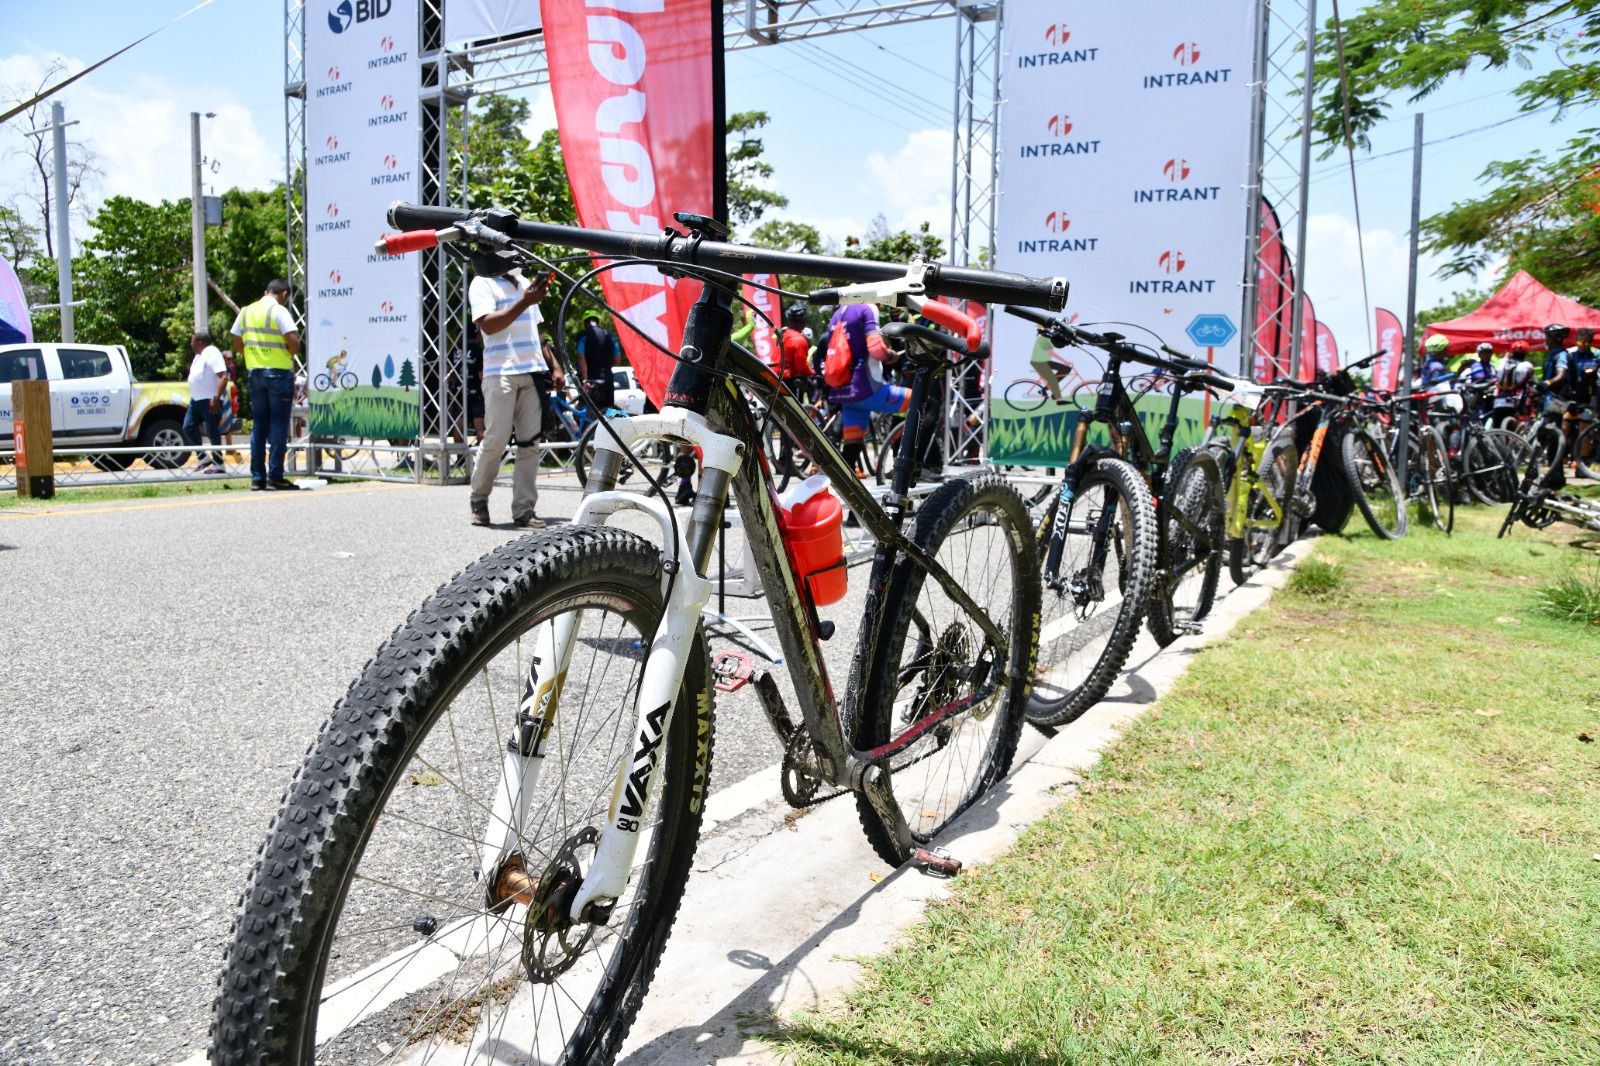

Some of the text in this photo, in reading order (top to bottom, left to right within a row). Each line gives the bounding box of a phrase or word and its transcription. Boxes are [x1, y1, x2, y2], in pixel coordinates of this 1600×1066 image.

[355, 0, 392, 23] BID
[368, 52, 408, 69] INTRANT
[1018, 48, 1099, 68] INTRANT
[1143, 69, 1232, 89] INTRANT
[316, 82, 353, 97] INTRANT
[368, 111, 408, 127] INTRANT
[1020, 140, 1101, 158] INTRANT
[315, 152, 351, 166] INTRANT
[371, 172, 411, 186] INTRANT
[1133, 187, 1221, 203] INTRANT
[315, 220, 351, 232] INTRANT
[1018, 238, 1099, 253] INTRANT
[318, 287, 354, 298] INTRANT
[1129, 280, 1216, 293] INTRANT
[368, 315, 408, 324] INTRANT
[1051, 500, 1070, 540] FOX
[1024, 612, 1040, 696] MAXXIS
[689, 687, 711, 816] MAXXIS
[616, 817, 640, 833] 30
